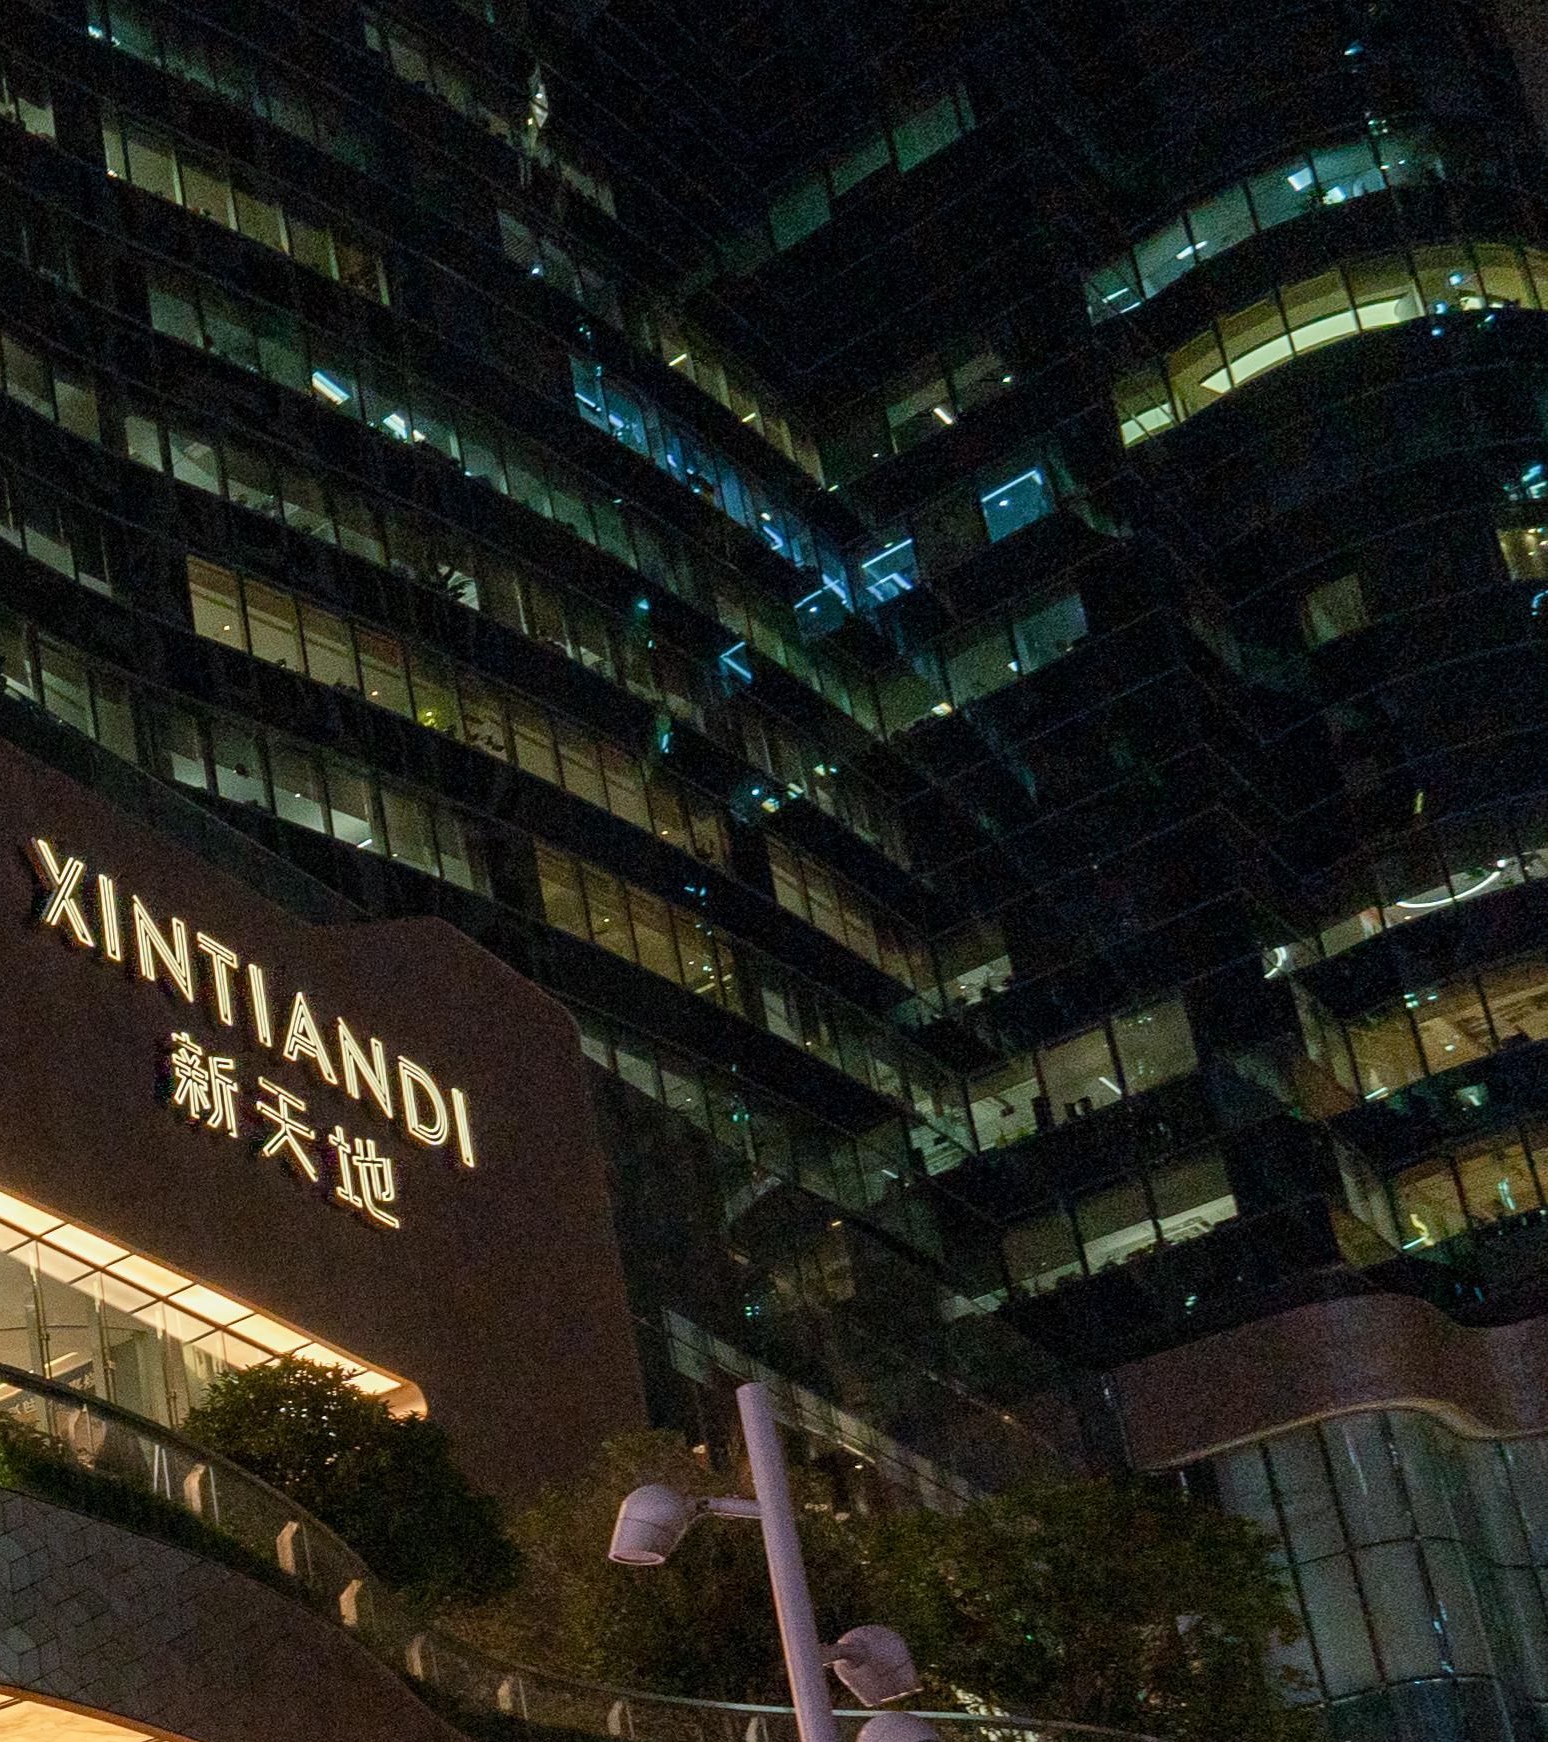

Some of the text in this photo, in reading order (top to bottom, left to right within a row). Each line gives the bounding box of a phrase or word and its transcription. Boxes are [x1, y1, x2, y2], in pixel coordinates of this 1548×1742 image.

[31, 837, 476, 1168] XINTIANDI
[170, 1030, 401, 1230] 新天地
